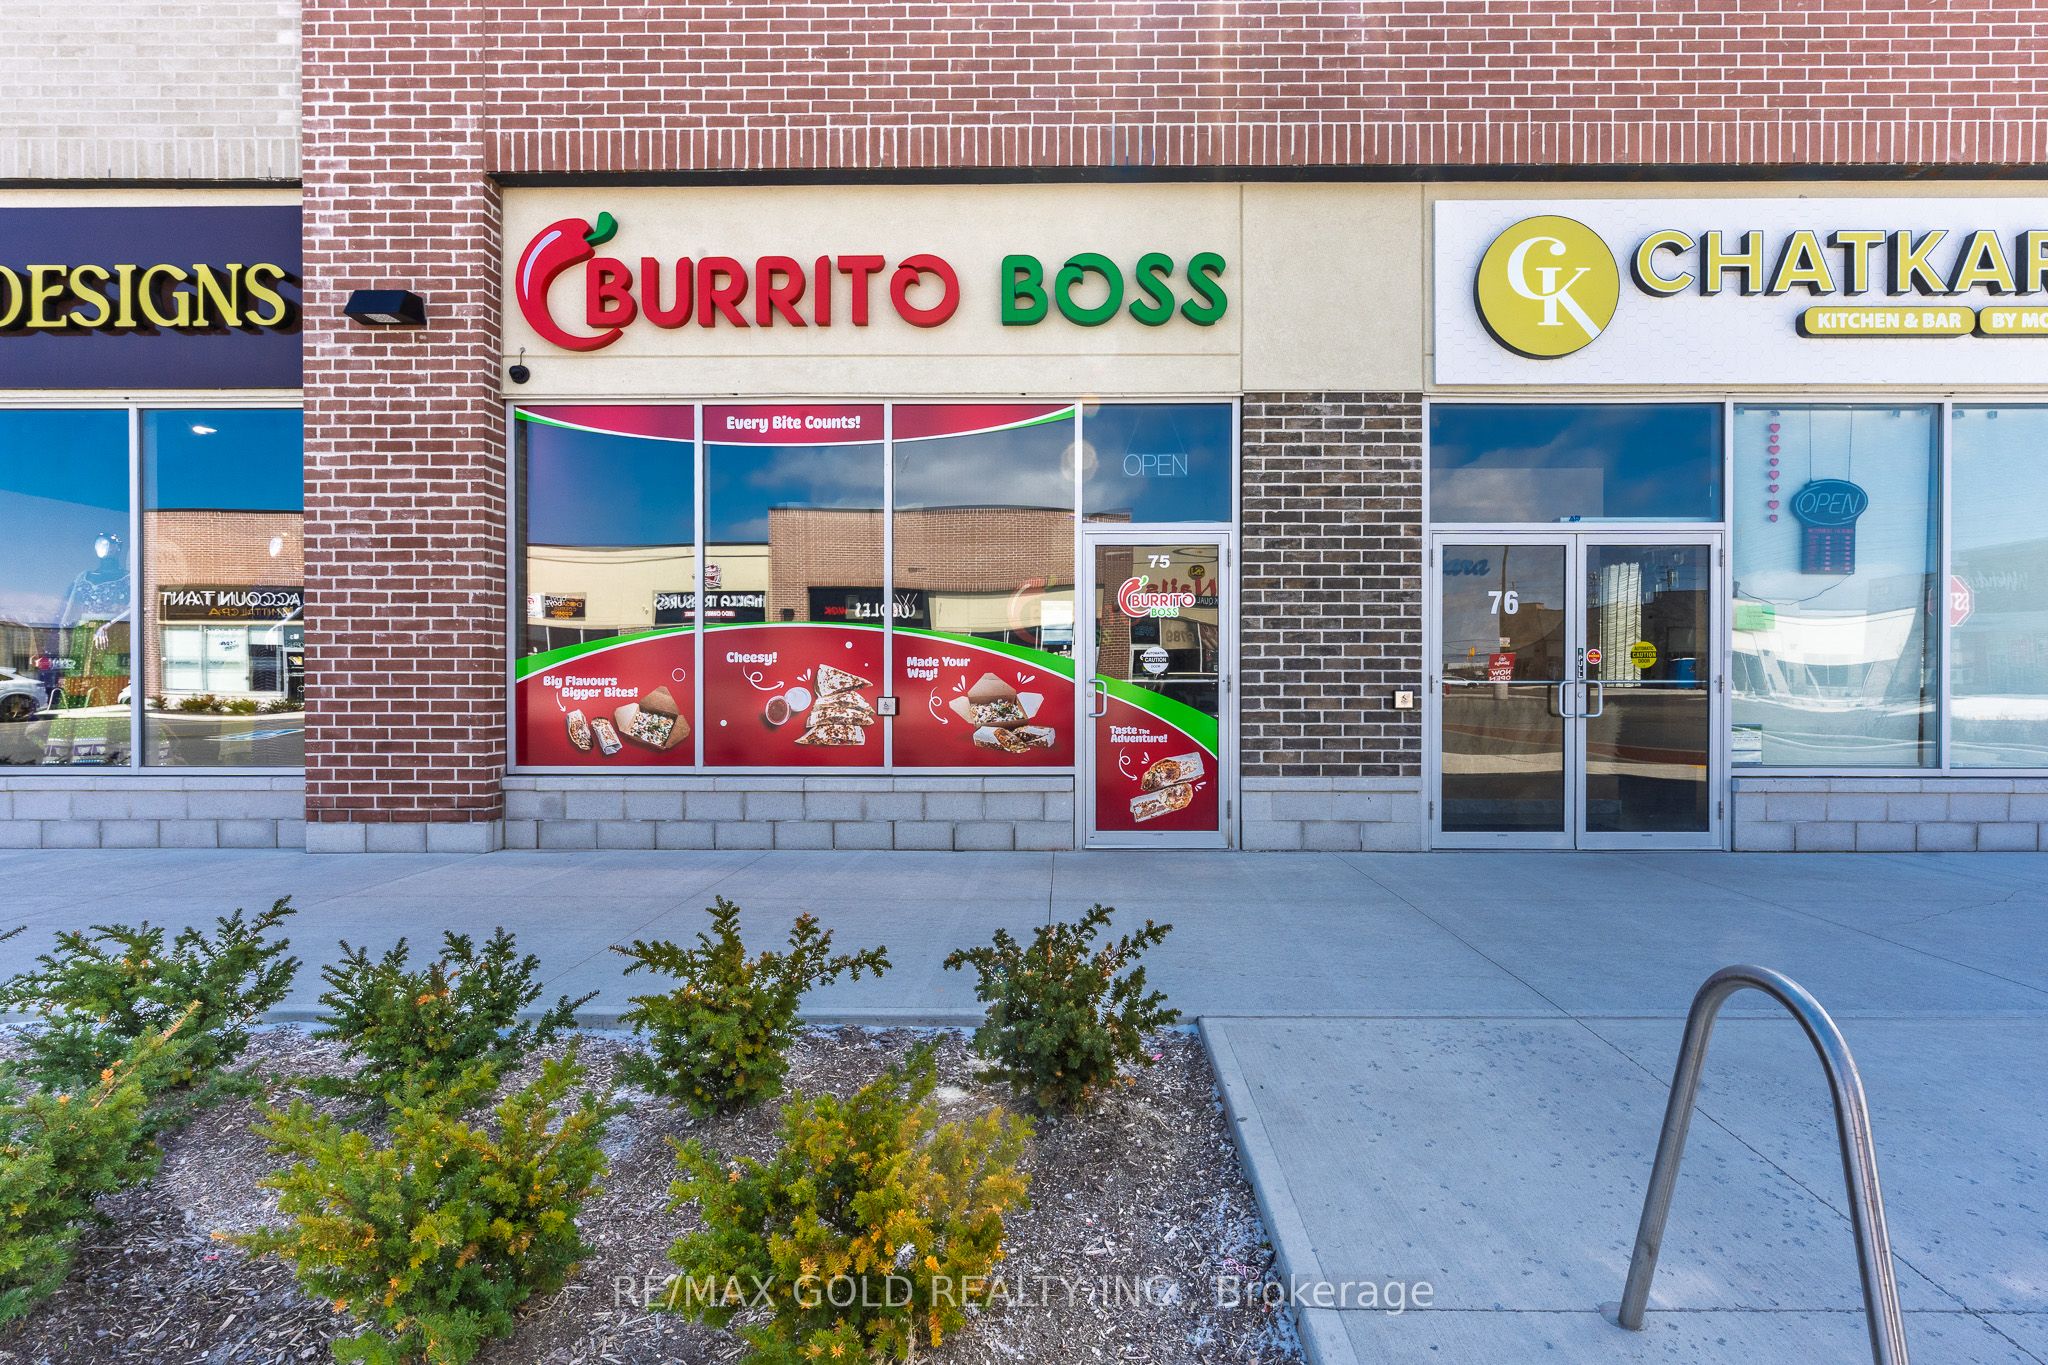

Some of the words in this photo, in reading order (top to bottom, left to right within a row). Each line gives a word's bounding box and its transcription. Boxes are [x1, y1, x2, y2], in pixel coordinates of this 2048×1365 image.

[586, 253, 960, 329] BURRITO
[1001, 252, 1228, 327] BOSS
[1818, 312, 1899, 329] KITCHEN
[1904, 312, 1919, 329] &
[1923, 312, 1962, 329] BAR
[1992, 312, 2017, 329] BY
[726, 416, 769, 434] Every
[772, 415, 801, 430] Bite
[805, 415, 861, 430] Counts!
[1123, 453, 1188, 476] OPEN
[1800, 493, 1861, 514] OPEN
[1148, 555, 1171, 569] 75
[1131, 593, 1195, 608] BURRITO
[1488, 591, 1519, 615] 76
[1151, 608, 1179, 617] BOSS
[726, 651, 778, 666] Cheesy!
[906, 656, 940, 668] Made
[942, 657, 971, 668] Your
[543, 675, 563, 689] Big
[565, 675, 618, 686] Flavours
[907, 667, 939, 682] Way!
[562, 687, 602, 700] Bigger
[603, 687, 639, 698] Bites!
[1110, 725, 1138, 735] Taste
[1110, 734, 1168, 743] Adventure!
